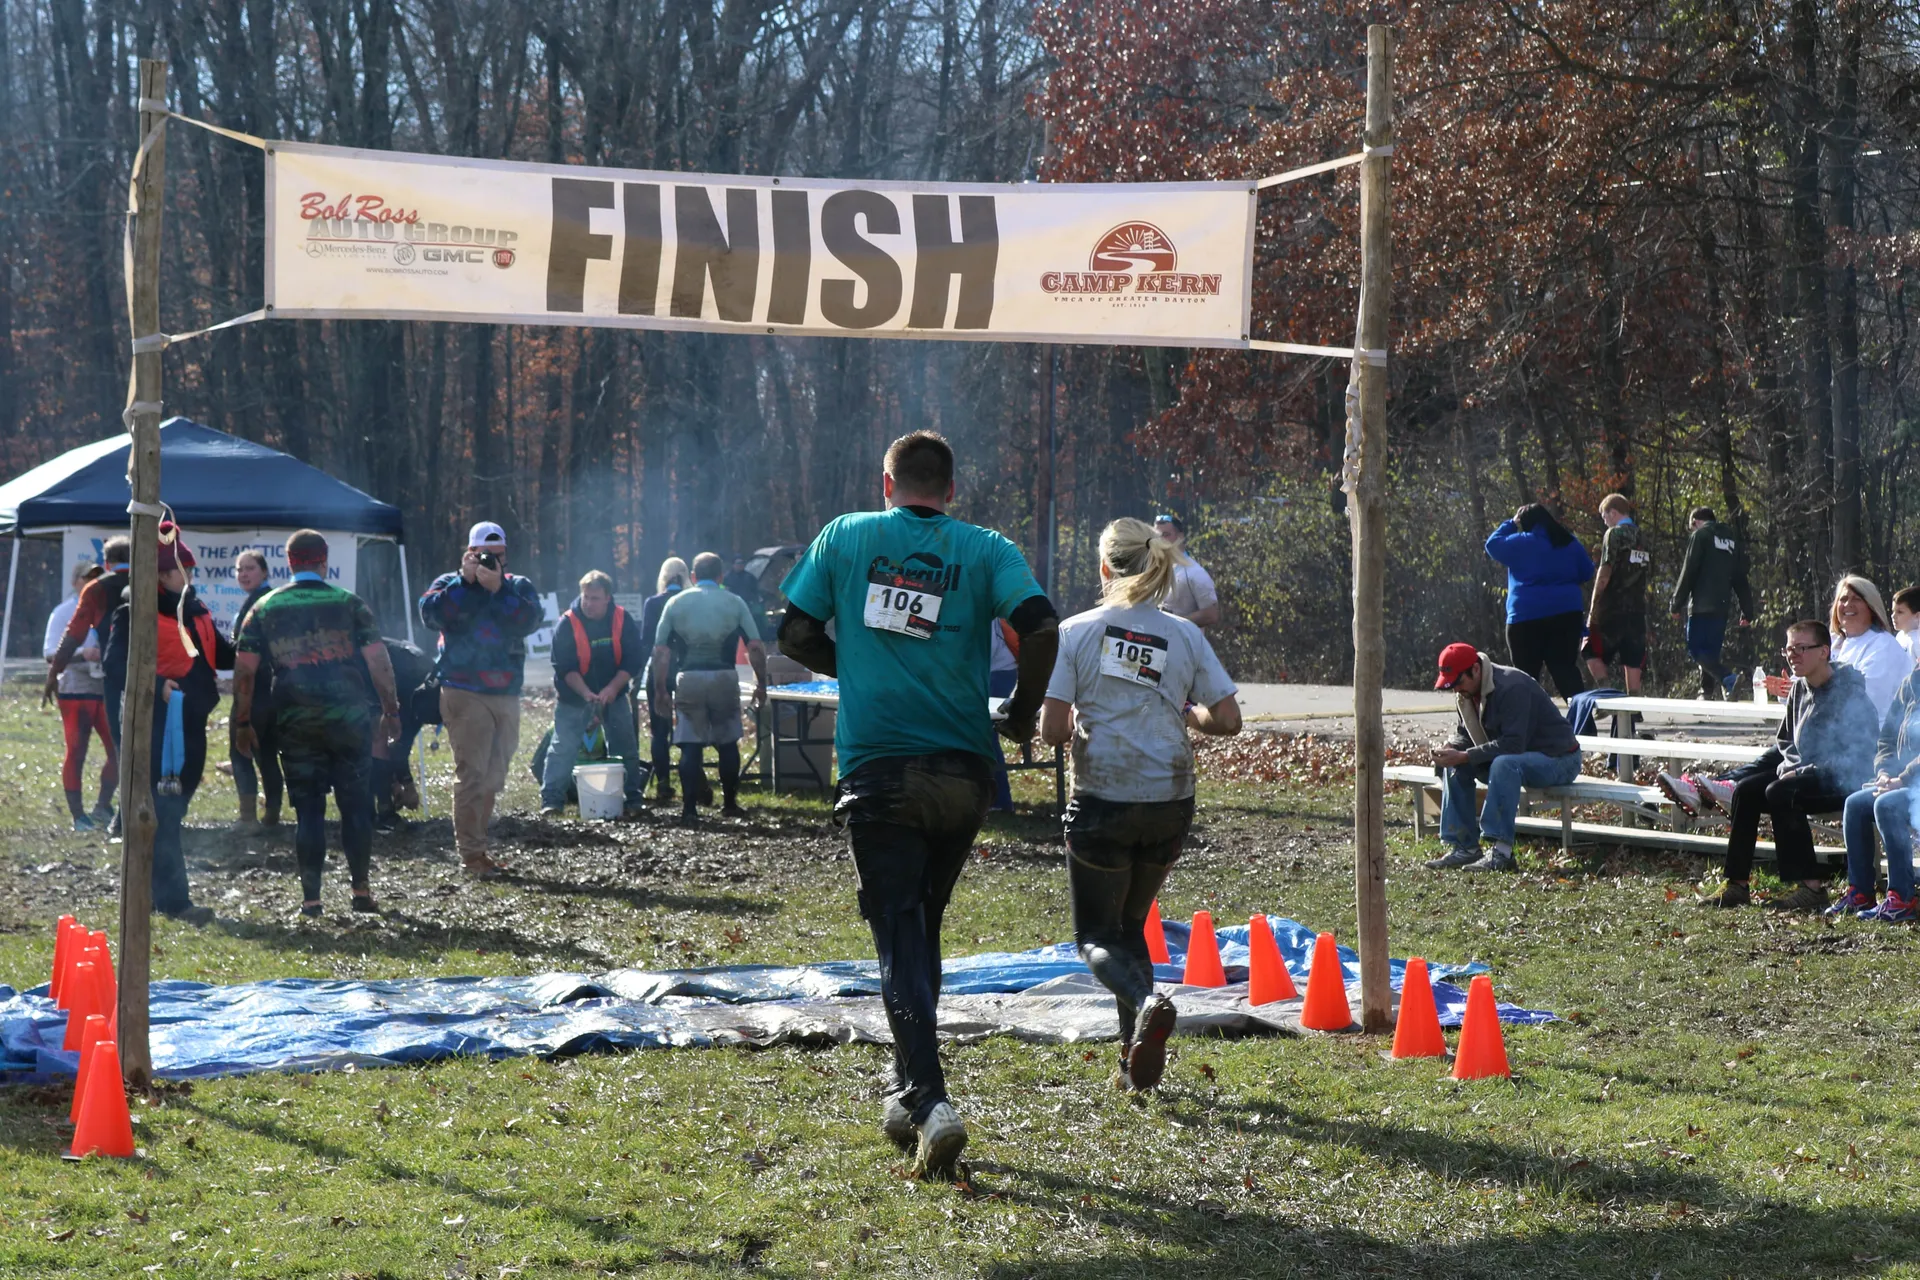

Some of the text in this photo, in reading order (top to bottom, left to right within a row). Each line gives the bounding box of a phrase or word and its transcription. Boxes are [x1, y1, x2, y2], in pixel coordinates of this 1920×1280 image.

[300, 192, 420, 225] Bob Ross
[307, 217, 518, 247] AUTO GROUP
[323, 243, 387, 255] Mercedes-Benz
[423, 249, 484, 263] GMC
[546, 177, 999, 330] FINISH
[1040, 271, 1222, 295] CAMP KERN
[198, 545, 227, 559] THE
[881, 588, 923, 615] 106
[1115, 641, 1154, 666] 105
